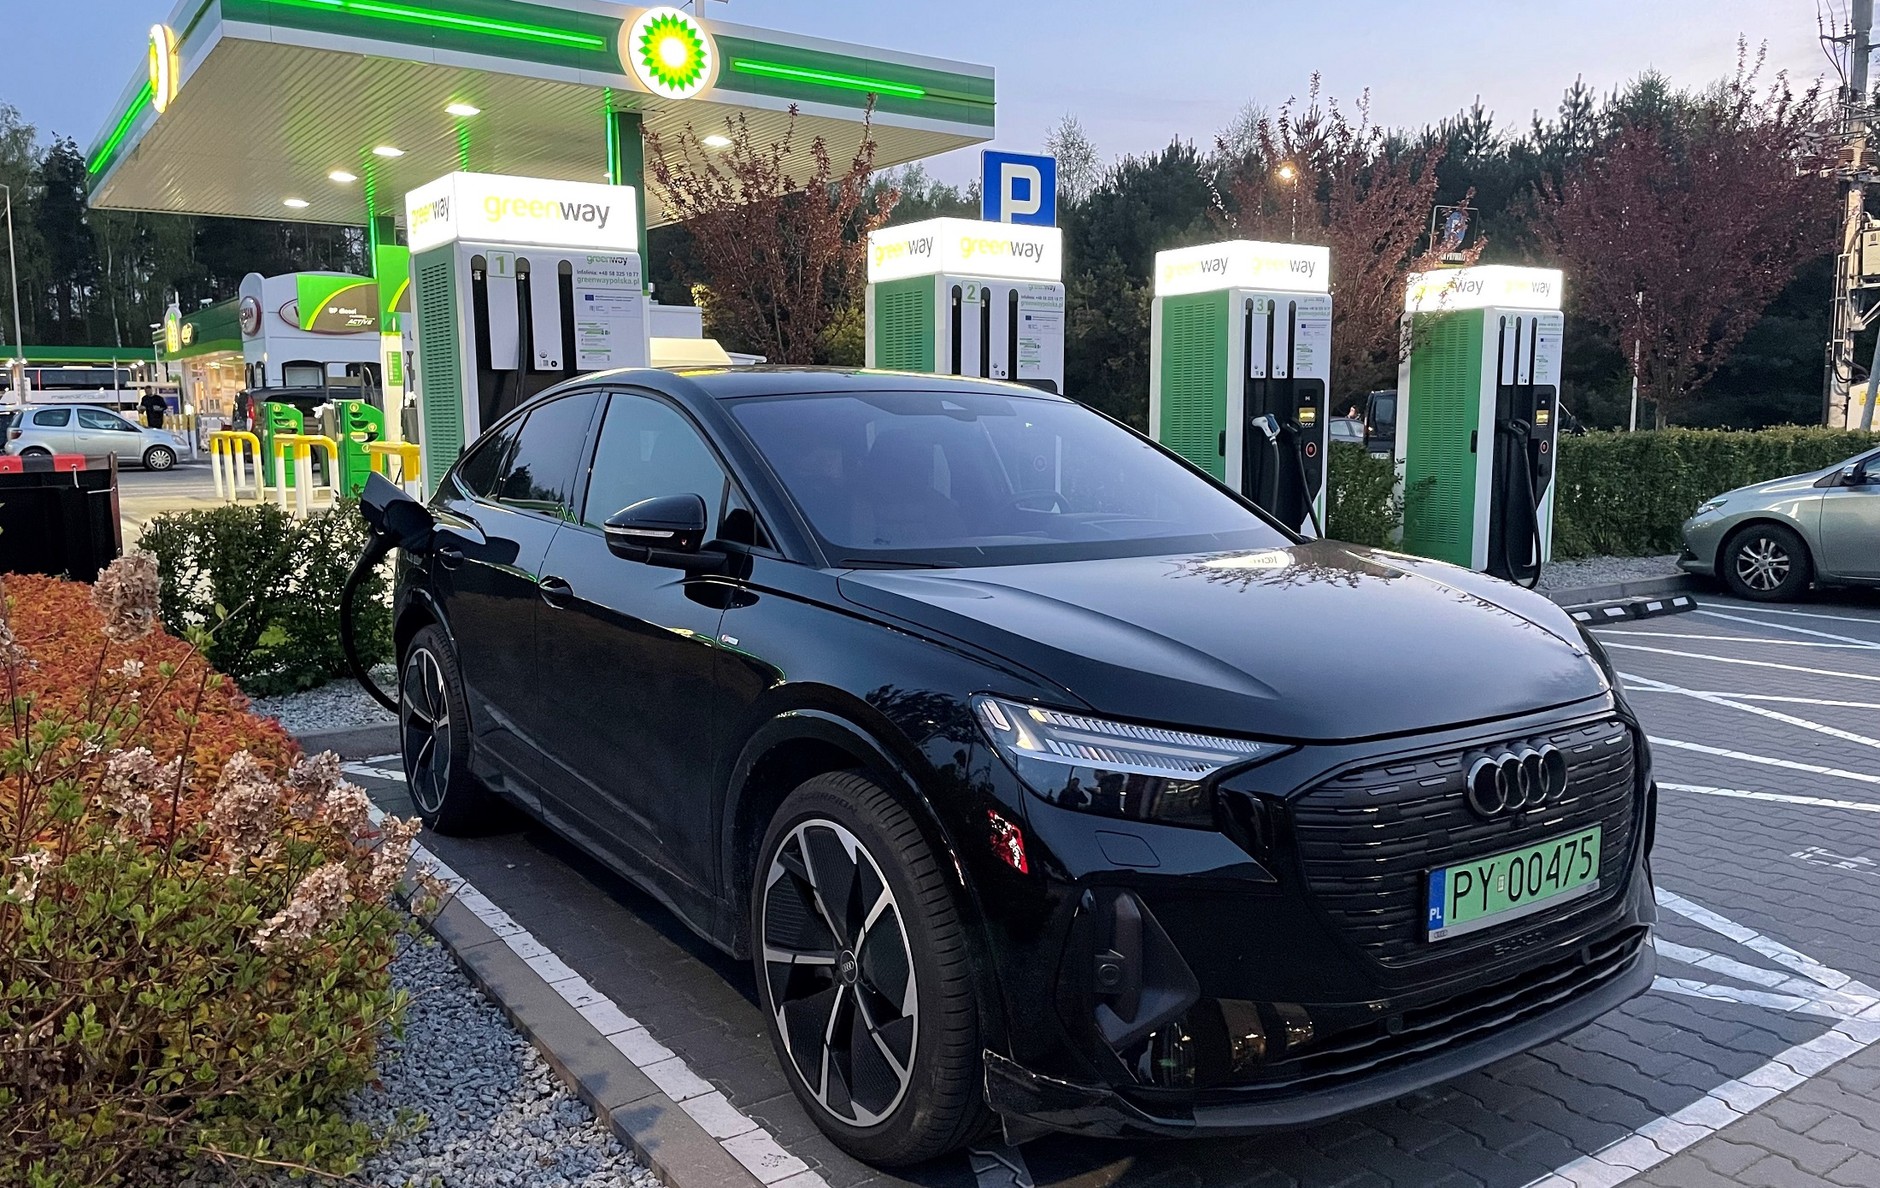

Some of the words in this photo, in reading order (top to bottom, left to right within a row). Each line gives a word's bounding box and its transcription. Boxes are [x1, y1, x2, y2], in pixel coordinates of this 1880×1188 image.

[1000, 162, 1042, 224] P
[411, 195, 450, 234] greenway
[483, 195, 610, 229] greenway
[960, 236, 1044, 263] greenway
[495, 255, 505, 275] 1
[586, 255, 628, 265] greenway
[1165, 256, 1229, 283] gway
[1252, 256, 1316, 278] gway
[576, 277, 640, 285] greenwaypolska.pl
[1415, 279, 1484, 300] gway
[1504, 279, 1551, 298] gway
[967, 284, 976, 300] 2
[1257, 298, 1264, 312] 3
[1508, 314, 1515, 327] 4
[1452, 863, 1495, 919] PY
[1507, 834, 1594, 902] 00475
[1429, 908, 1442, 921] PL
